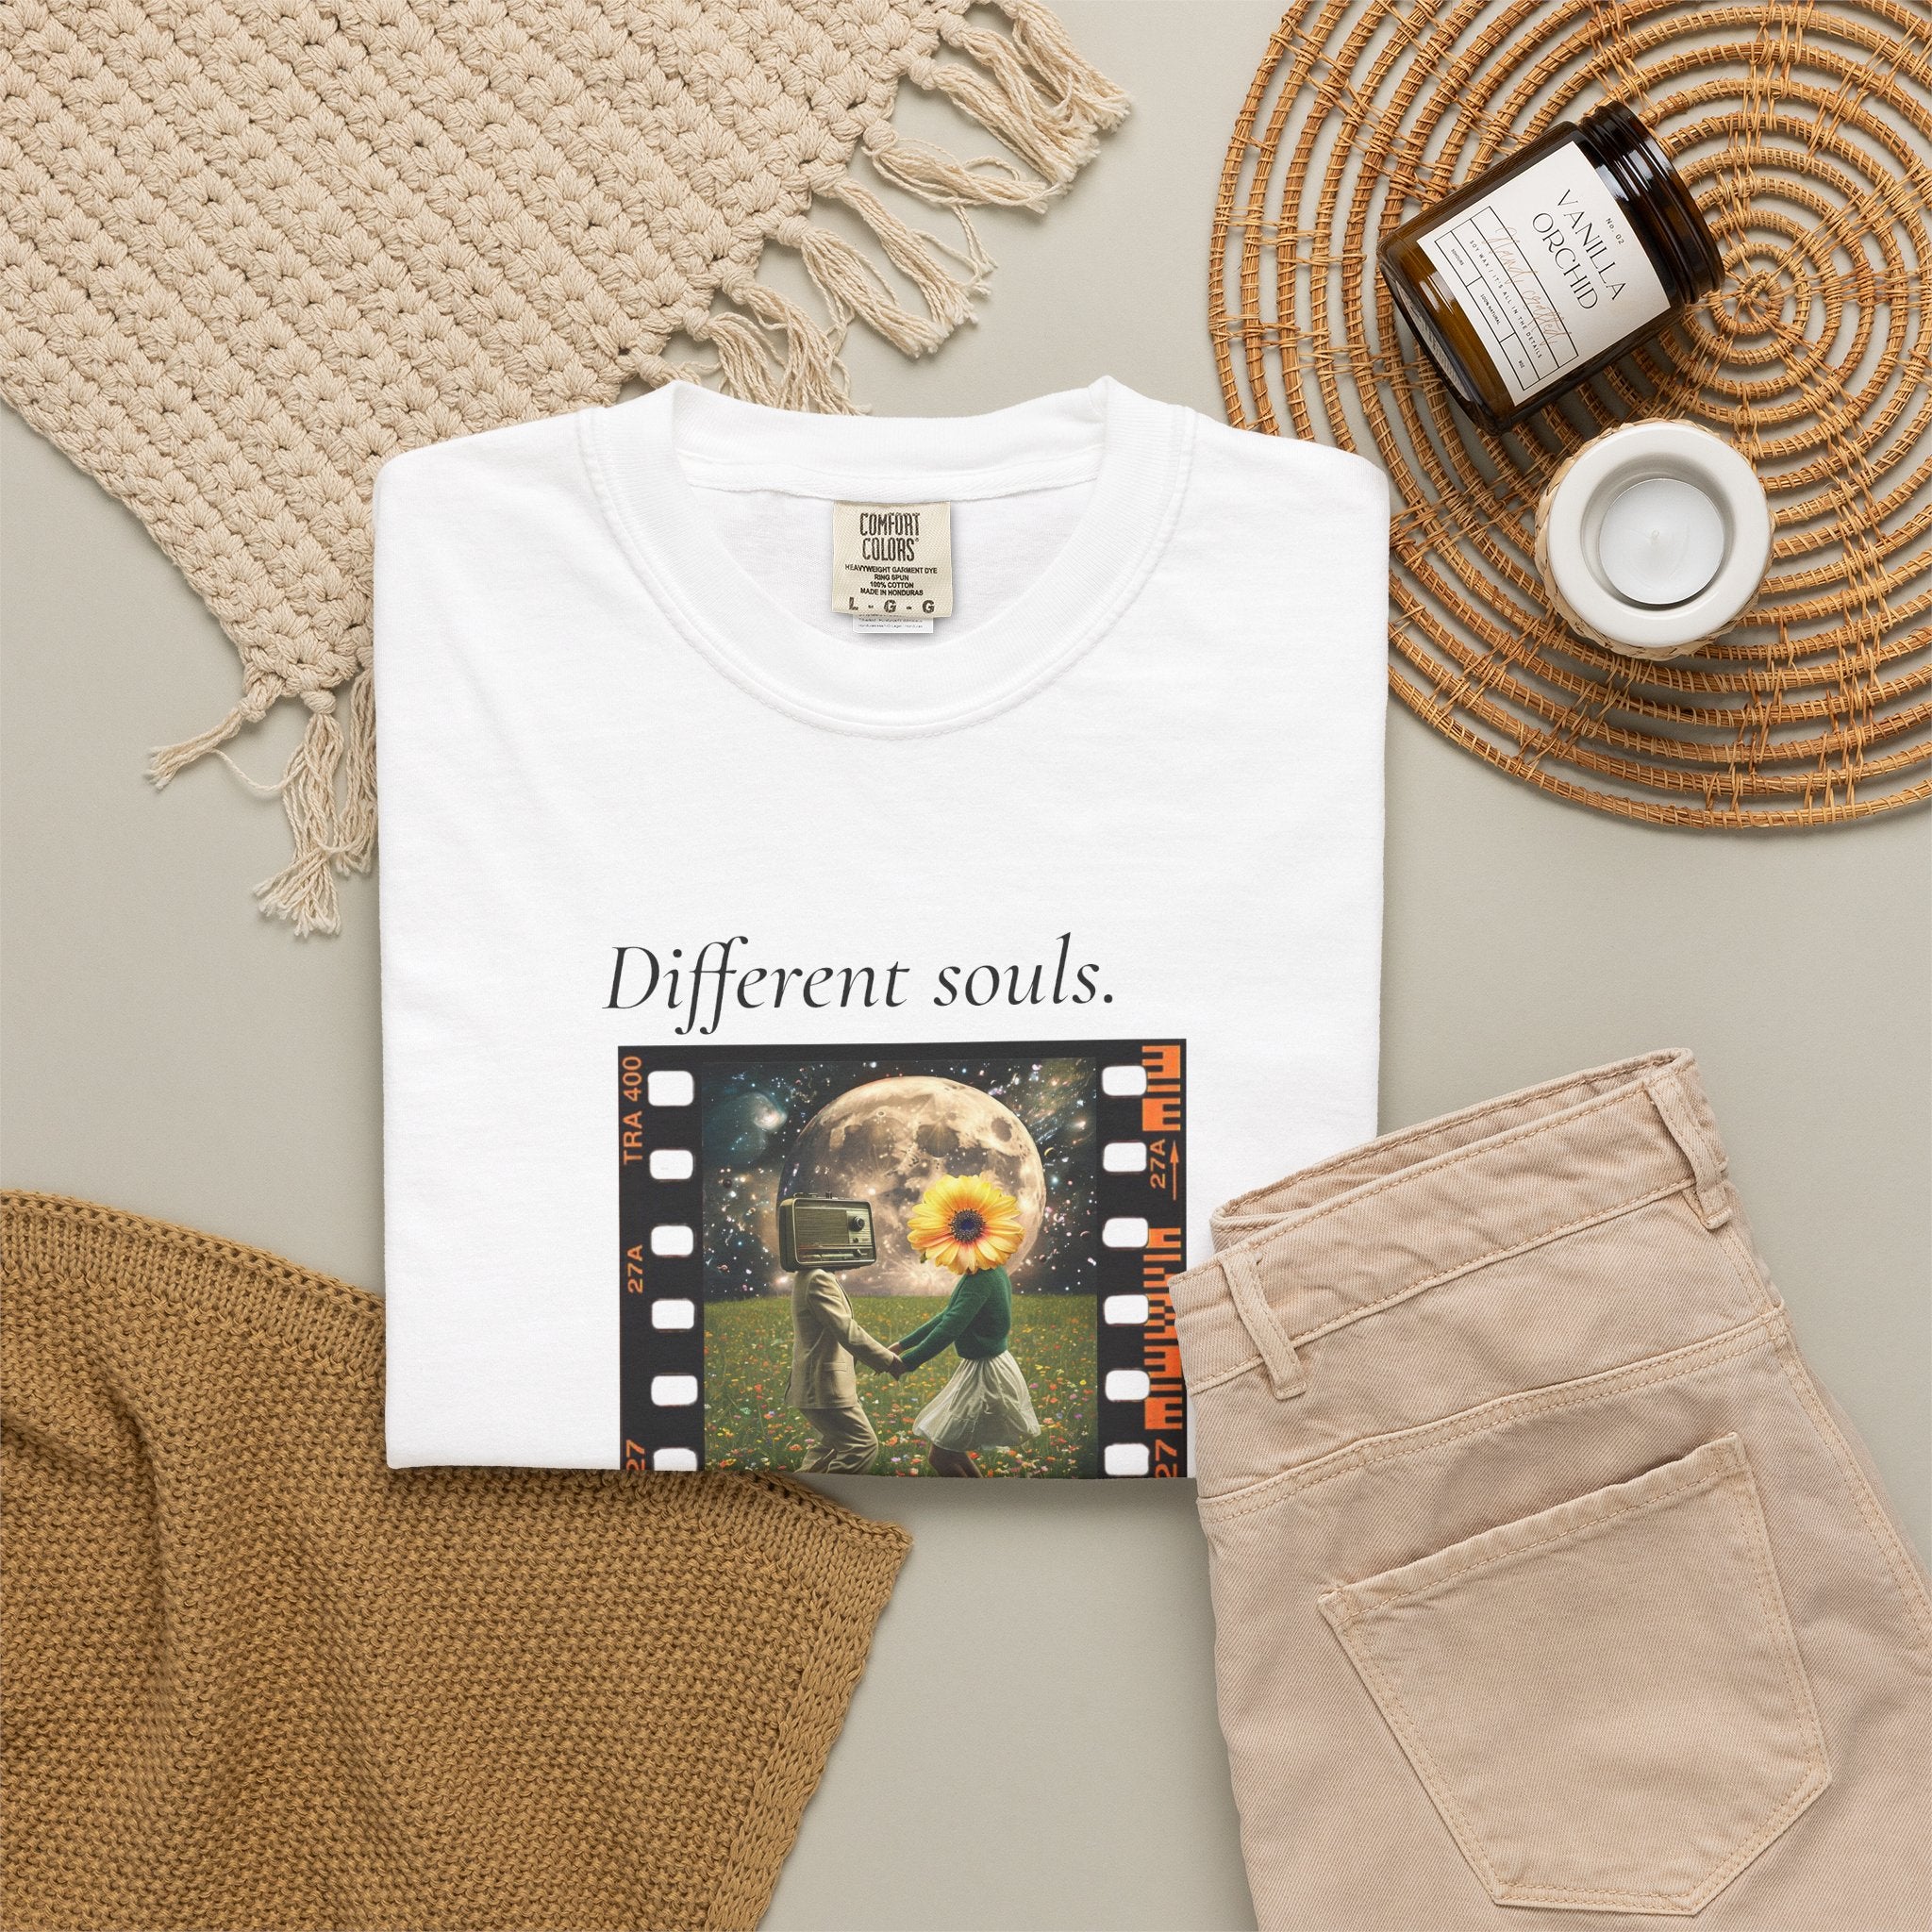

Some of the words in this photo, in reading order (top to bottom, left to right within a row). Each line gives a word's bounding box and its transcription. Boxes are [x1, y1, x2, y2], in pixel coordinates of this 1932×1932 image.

[1557, 189, 1626, 300] VANILLA
[1606, 218, 1615, 232] No.
[1615, 233, 1624, 245] 02
[1532, 212, 1598, 309] ORCHID
[1470, 240, 1480, 251] SOY
[1479, 254, 1490, 267] WAX
[1503, 291, 1512, 304] ALL
[1511, 306, 1519, 315] IN
[1518, 316, 1527, 330] THE
[1526, 332, 1542, 358] DETAILS
[859, 512, 920, 536] COMFORT
[845, 564, 891, 574] HEAVYWEIGHT
[883, 599, 897, 613] G
[922, 599, 935, 613] G
[602, 935, 911, 1036] Different
[932, 932, 1114, 1007] souls.
[622, 1056, 642, 1102] 400
[623, 1110, 642, 1166] TRA
[1149, 1138, 1167, 1189] 27A
[626, 1243, 644, 1295] 27A
